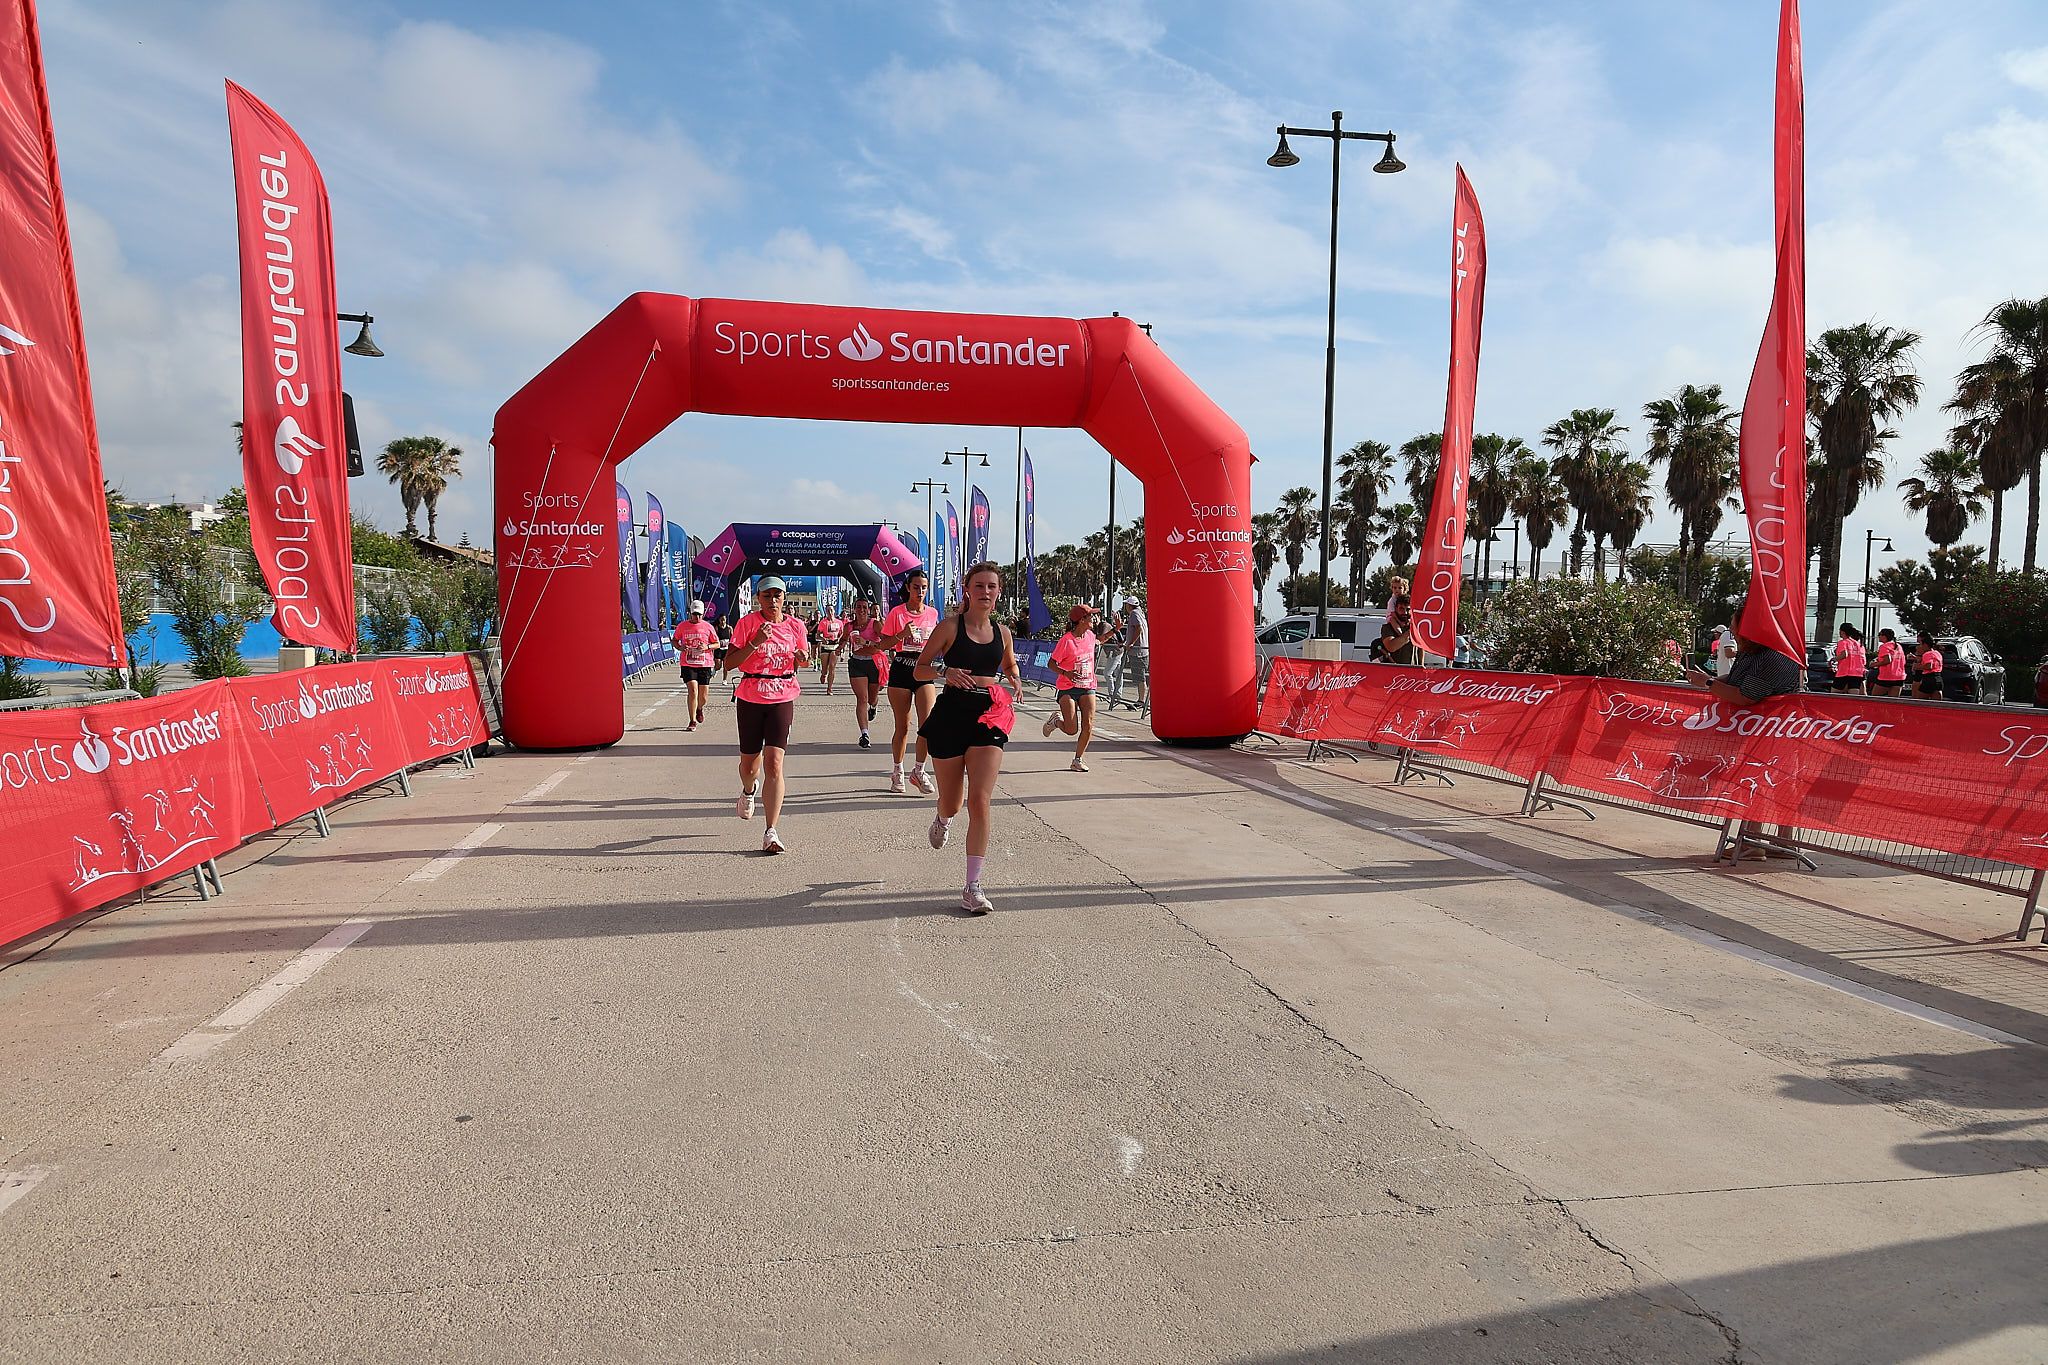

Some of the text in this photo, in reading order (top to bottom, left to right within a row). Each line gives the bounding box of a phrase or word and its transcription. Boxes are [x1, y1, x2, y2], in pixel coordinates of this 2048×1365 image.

[714, 321, 1070, 367] Sports Santander
[831, 376, 950, 392] sportssantander.es
[523, 491, 579, 511] Sports
[1191, 502, 1237, 520] Sports
[519, 520, 604, 536] Santander
[782, 530, 845, 541] octopus energy
[1186, 528, 1250, 543] Santander
[759, 558, 837, 567] VOLVO
[392, 669, 426, 702] Sports
[1383, 673, 1554, 706] Sports Santander
[251, 678, 373, 738] Sports Santander
[1598, 692, 1896, 746] Sports Santander
[0, 710, 221, 790] orts Santander
